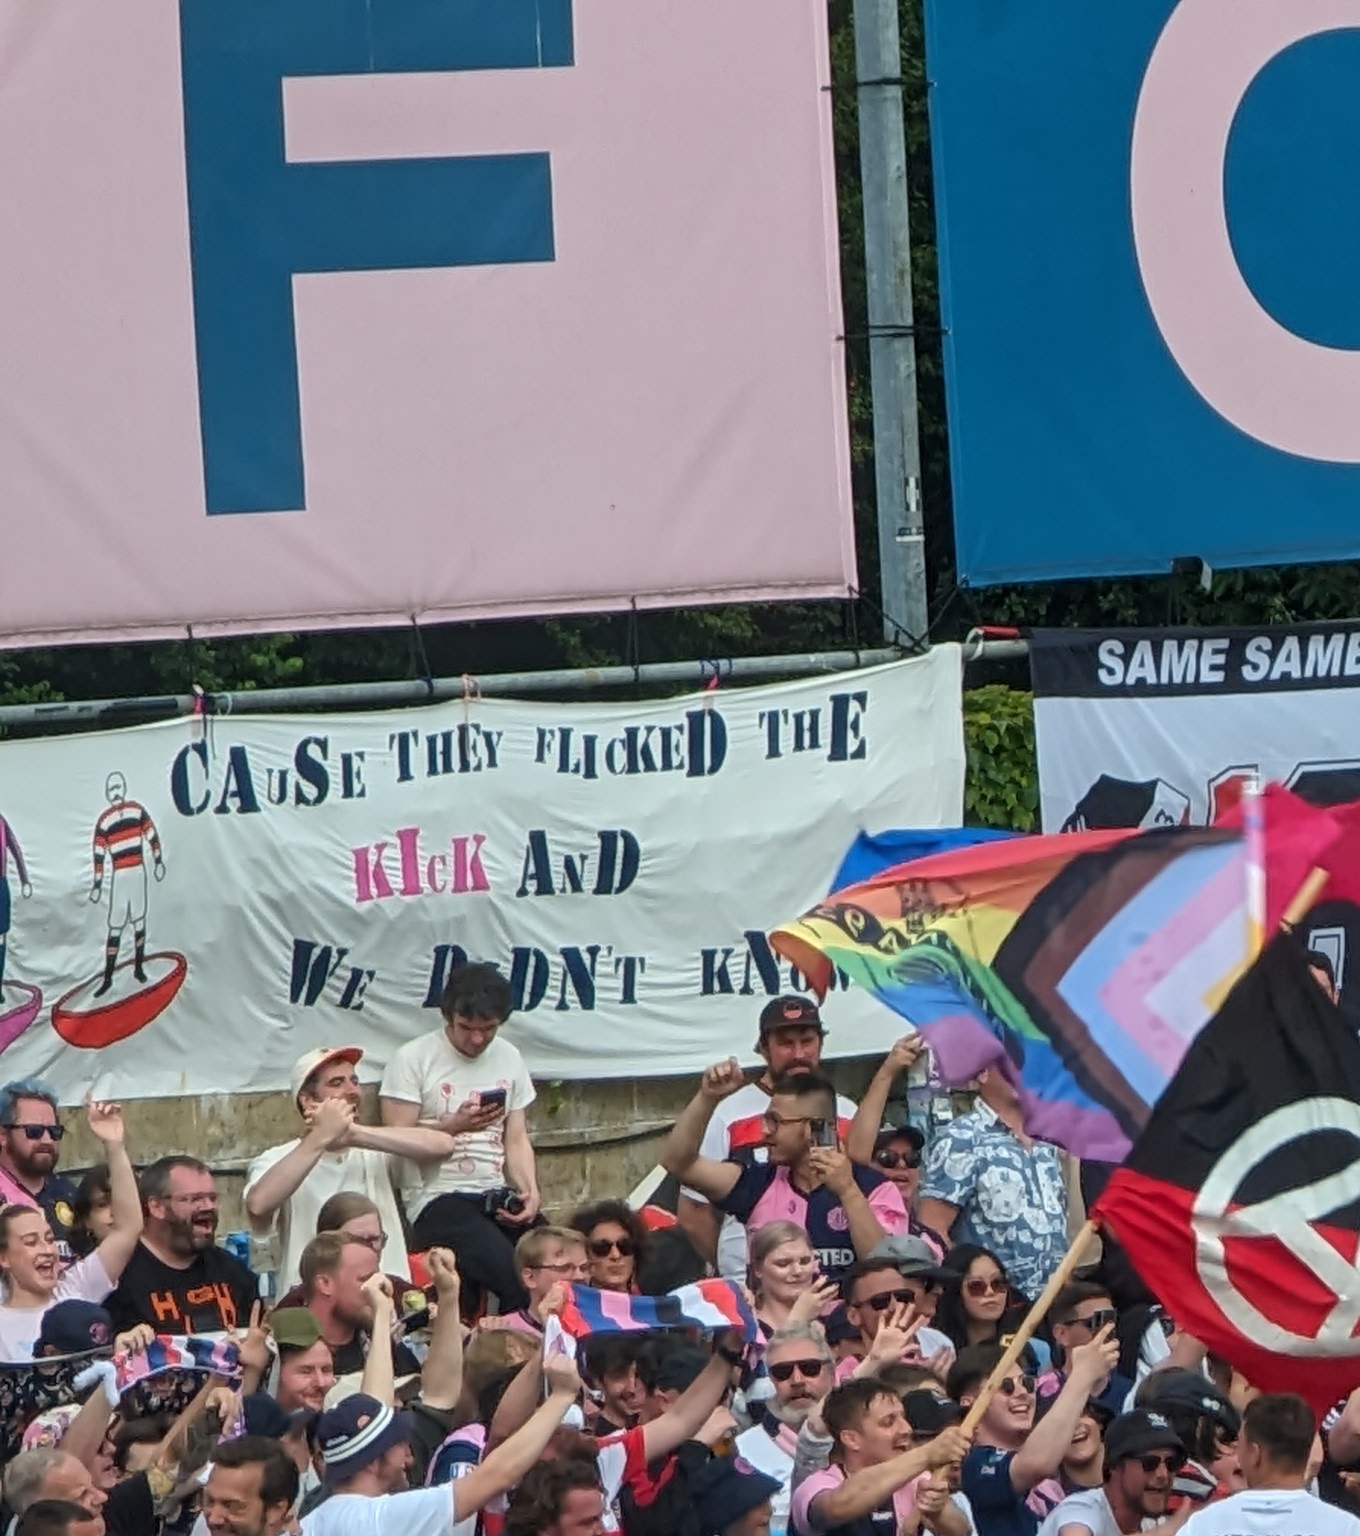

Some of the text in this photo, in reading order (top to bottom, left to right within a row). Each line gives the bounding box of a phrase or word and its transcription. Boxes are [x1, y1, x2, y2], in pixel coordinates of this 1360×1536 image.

[1098, 638, 1227, 686] SAME
[389, 722, 504, 783] THEY
[534, 707, 728, 779] FLICKED
[758, 691, 868, 762] THE
[515, 829, 641, 898] AND
[289, 938, 375, 1009] WE
